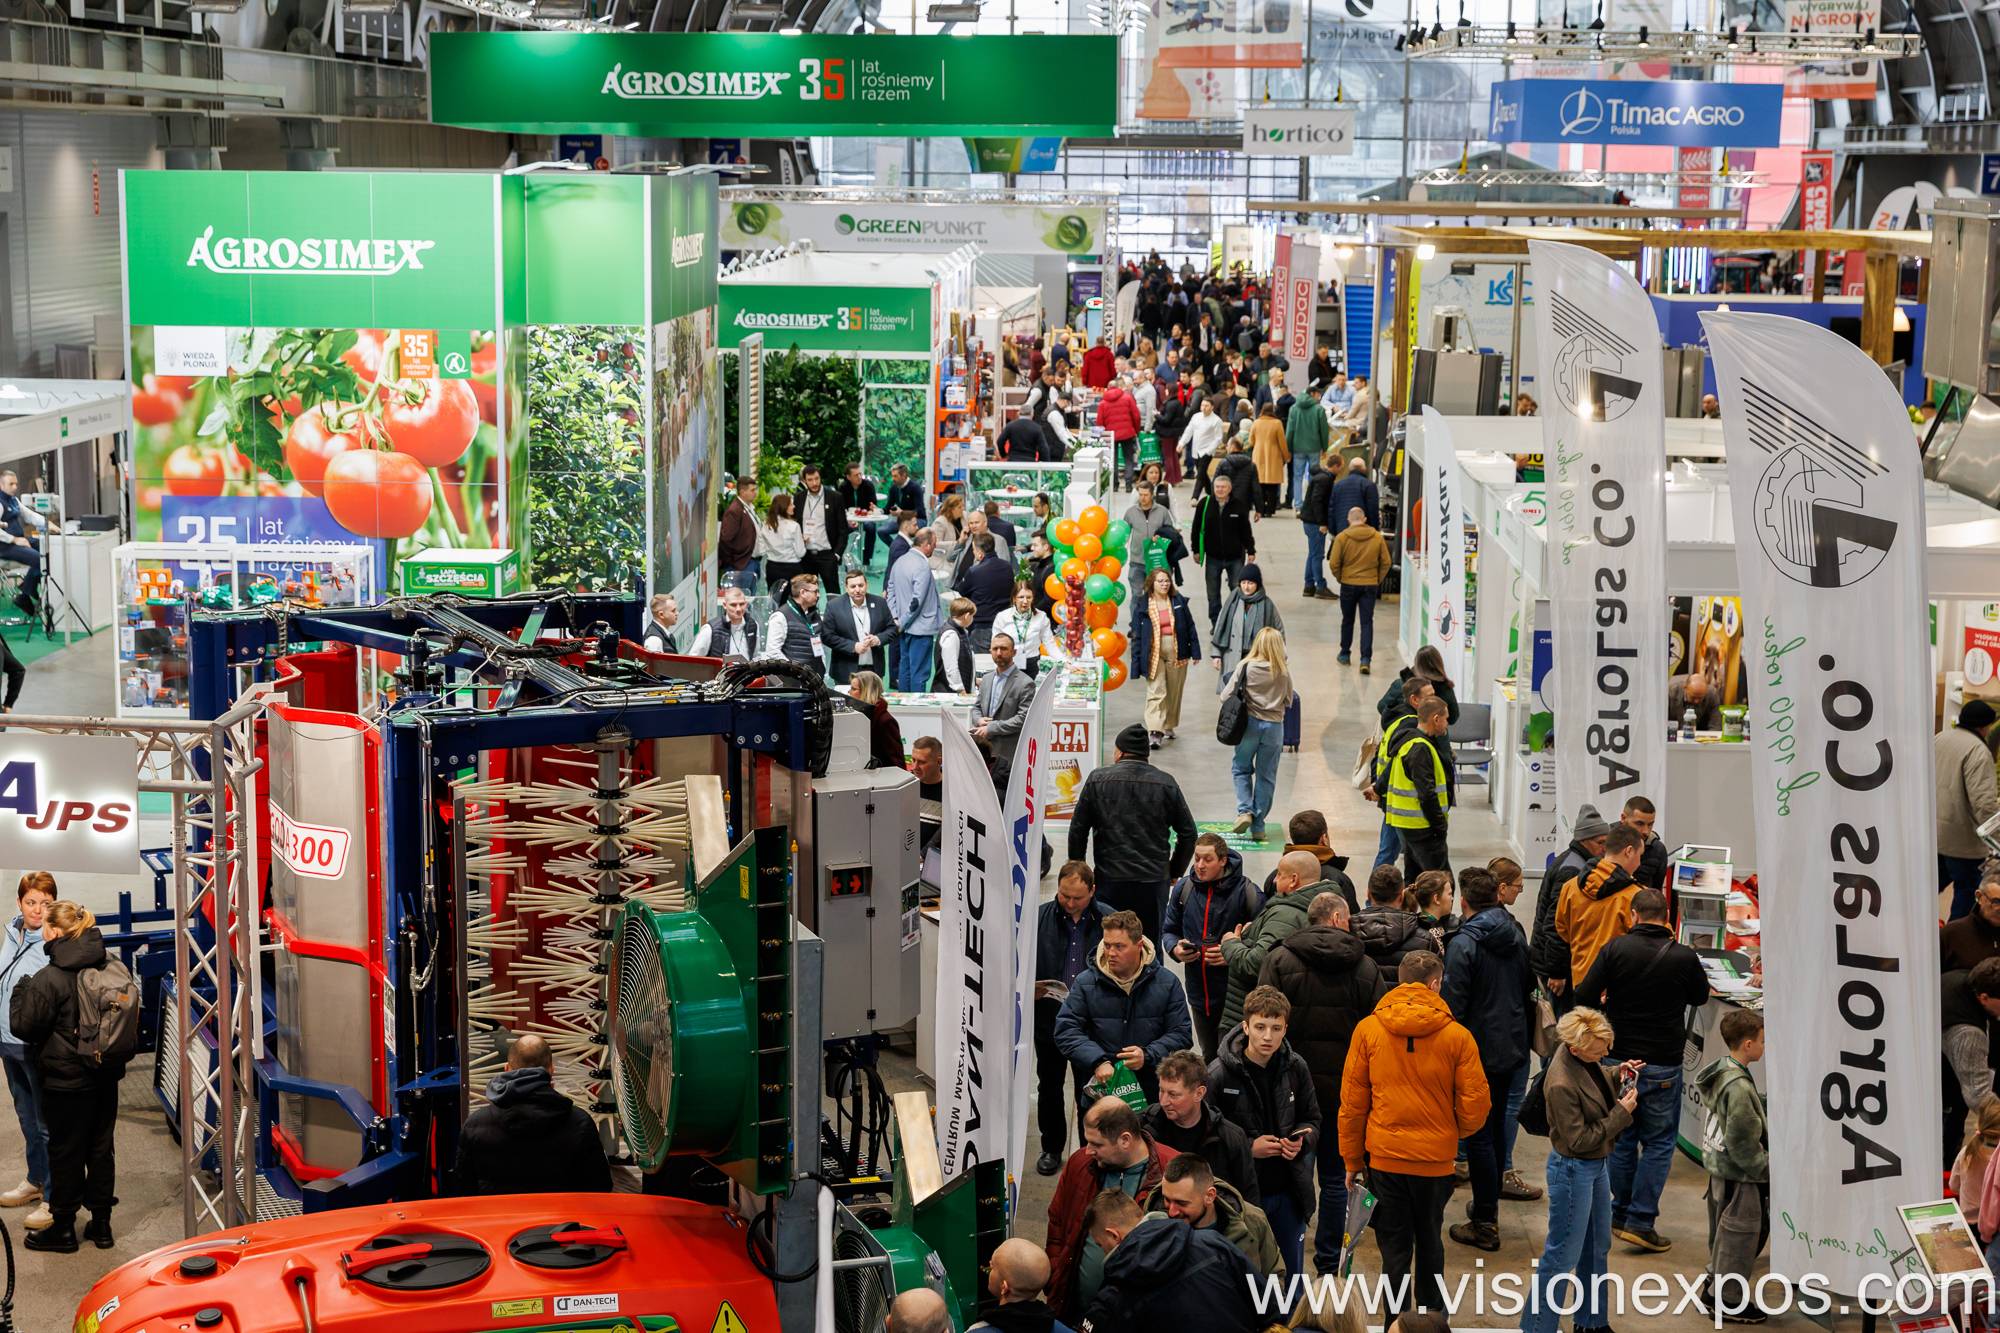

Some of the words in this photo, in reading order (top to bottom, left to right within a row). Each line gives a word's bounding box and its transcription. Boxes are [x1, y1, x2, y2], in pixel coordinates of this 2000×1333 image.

[861, 59, 880, 73] lat
[601, 63, 791, 99] AGROSIMEX
[800, 58, 844, 100] 35
[861, 73, 934, 90] rośniemy
[861, 88, 910, 100] razem
[1606, 98, 1681, 125] Timac
[1682, 106, 1745, 126] AGRO
[1253, 124, 1344, 143] hortico
[1611, 126, 1641, 135] Polska
[856, 218, 986, 235] GREENPUNKT
[186, 225, 435, 275] AGROSIMEX
[733, 308, 834, 329] AGROSIMEX
[837, 307, 862, 330] 35
[869, 308, 880, 316] lat
[869, 323, 896, 331] razem
[404, 335, 428, 357] 35
[183, 352, 215, 360] WIEDZA
[259, 517, 284, 535] lat
[1026, 736, 1037, 825] JPS
[26, 800, 131, 832] JPS
[292, 833, 334, 867] 300
[573, 1297, 616, 1307] DAN-TECH
